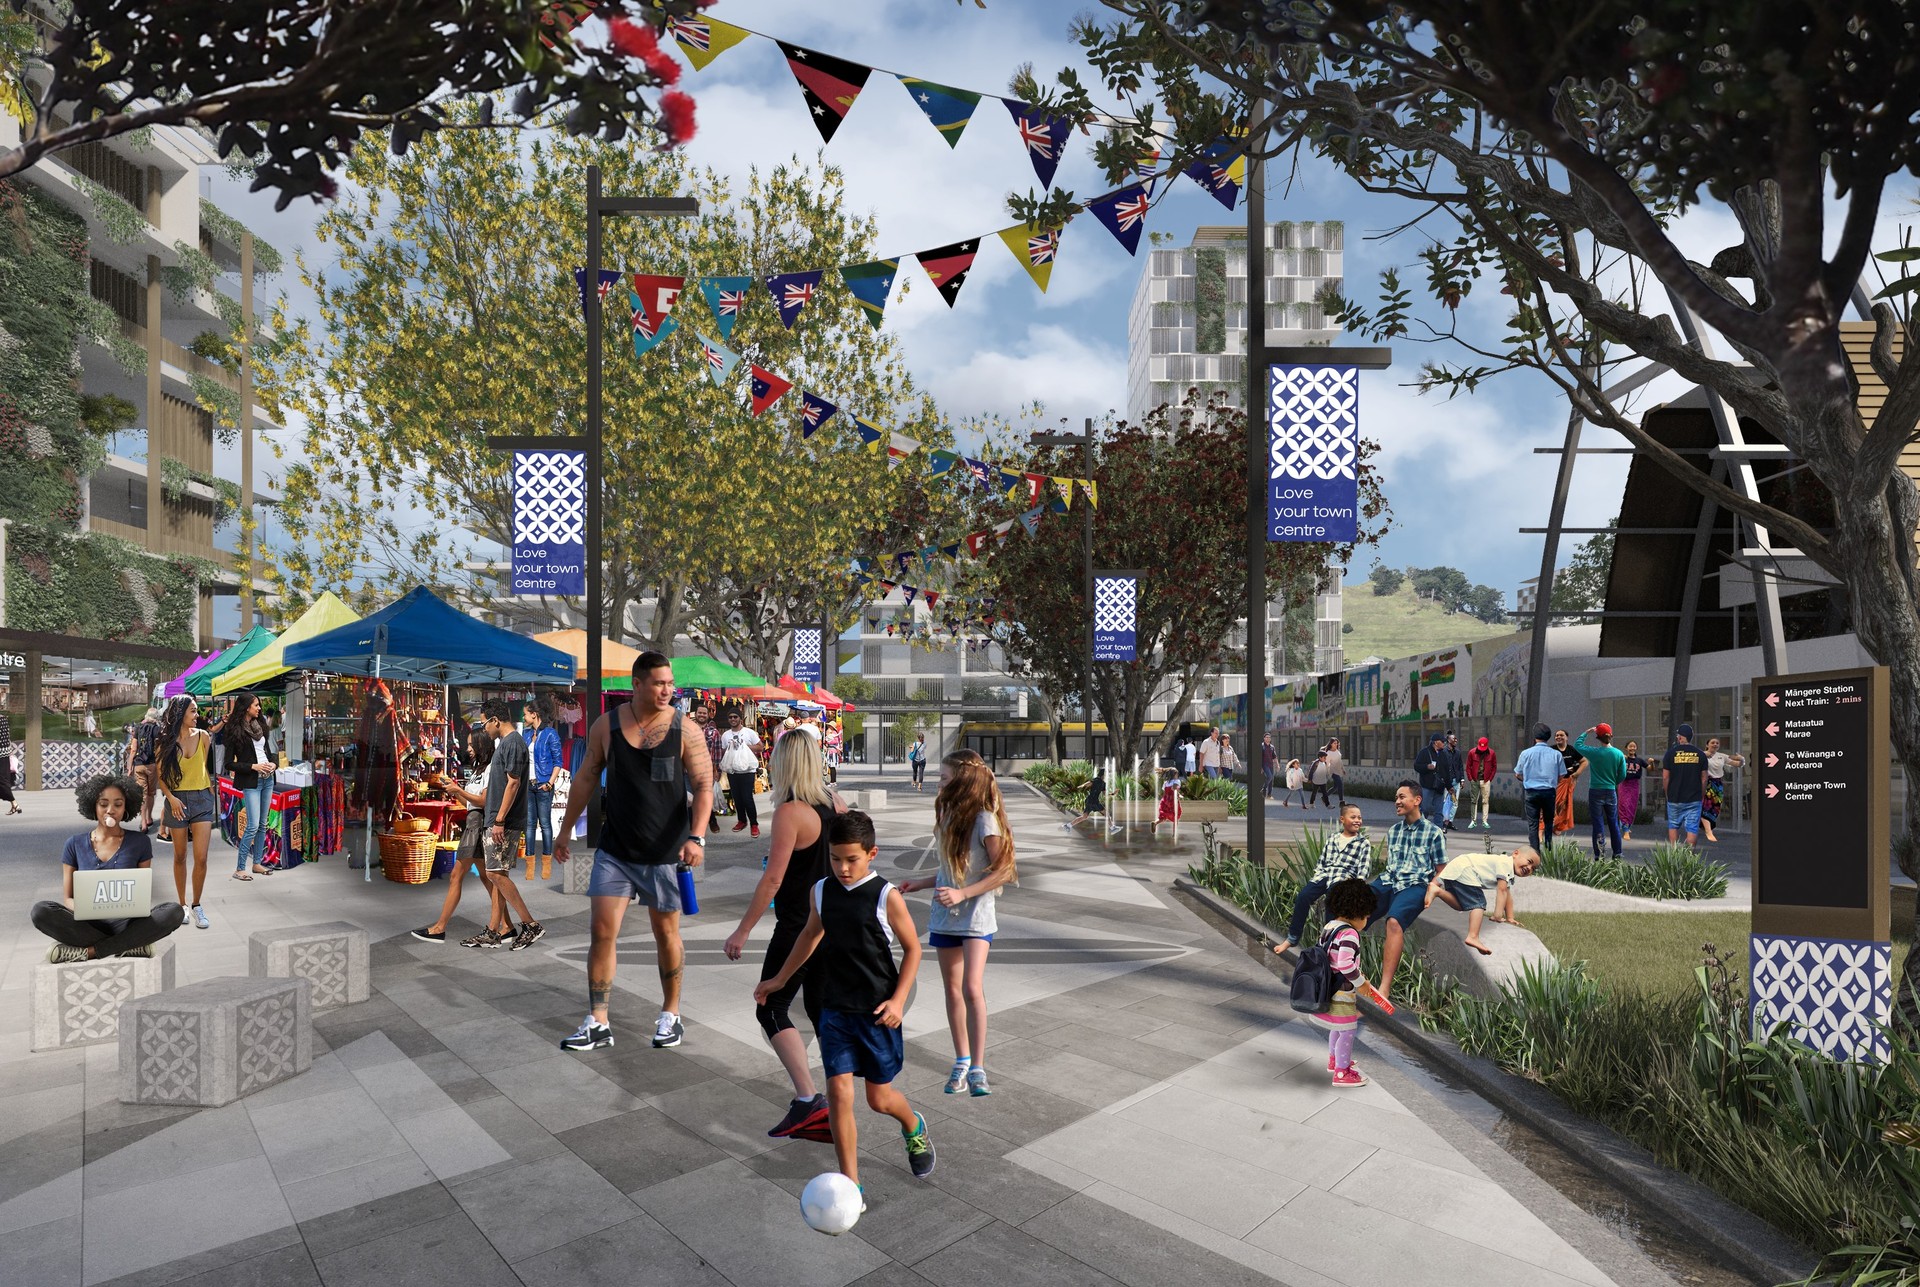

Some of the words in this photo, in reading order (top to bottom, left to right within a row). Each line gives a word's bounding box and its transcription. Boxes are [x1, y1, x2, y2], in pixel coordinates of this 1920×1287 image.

[1275, 486, 1314, 499] Love
[1274, 507, 1310, 520] your
[1313, 506, 1353, 518] town
[1274, 524, 1326, 537] centre
[515, 548, 547, 558] Love
[515, 564, 542, 575] your
[546, 563, 579, 574] town
[515, 578, 556, 589] centre
[1095, 644, 1113, 652] your
[1095, 652, 1121, 660] centre
[1823, 685, 1854, 694] Station
[1785, 699, 1805, 707] Next
[1806, 697, 1829, 706] Train:
[1842, 696, 1862, 704] mins
[1785, 719, 1824, 728] Mataatua
[1785, 730, 1811, 739] Marae
[1785, 751, 1795, 759] Te
[1785, 762, 1823, 770] Aotearoa
[1823, 781, 1846, 789] Town
[1785, 792, 1813, 801] Centre
[93, 880, 136, 904] AUT
[93, 903, 136, 911] UNIVERSITY
